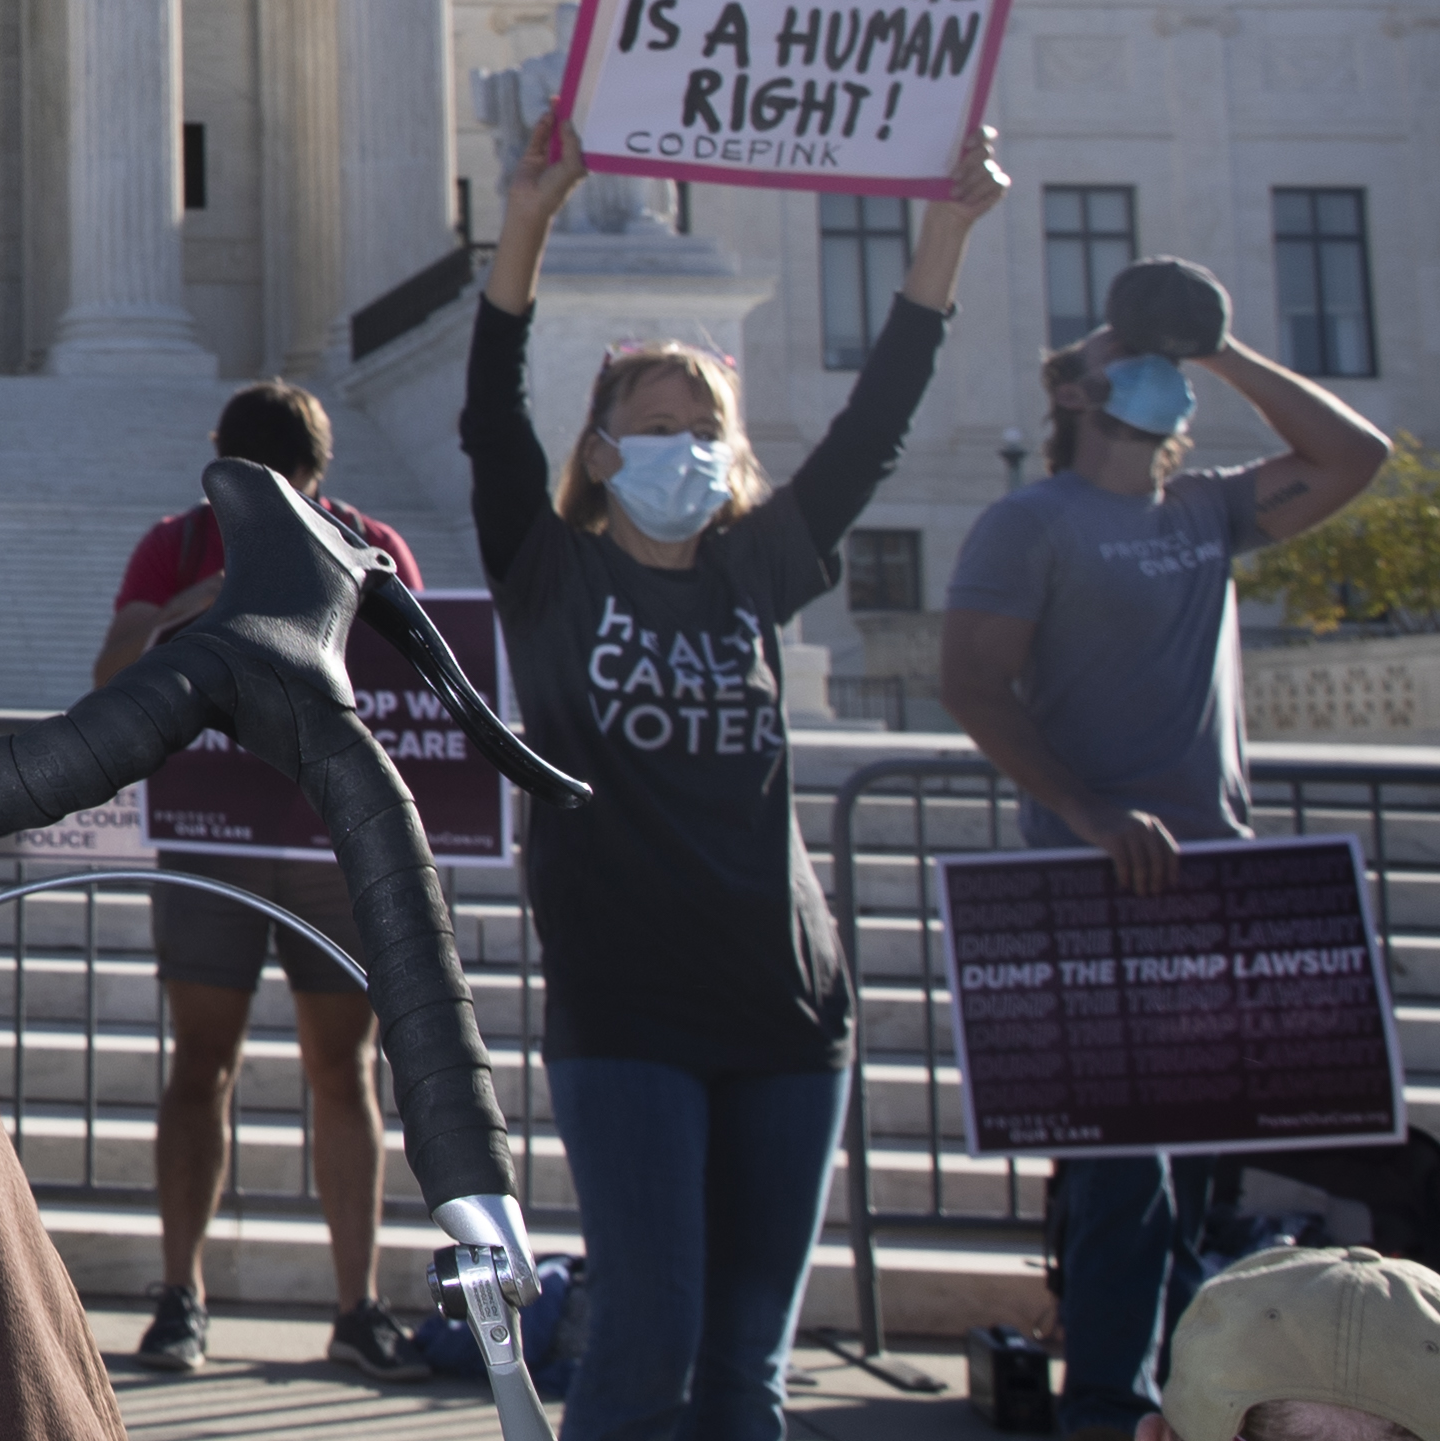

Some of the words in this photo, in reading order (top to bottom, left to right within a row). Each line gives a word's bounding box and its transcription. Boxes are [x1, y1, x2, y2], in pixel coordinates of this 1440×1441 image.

[702, 2, 749, 67] A
[776, 6, 980, 80] HUMAN
[682, 69, 902, 141] RIGHT!
[625, 132, 842, 167] CODEPINK
[589, 643, 745, 702] CARE
[354, 690, 397, 721] OP
[588, 691, 784, 754] VOTER
[373, 730, 467, 759] CARE
[76, 810, 141, 828] COUR
[15, 830, 96, 849] POLICE
[962, 962, 1052, 991] DUMP
[1060, 958, 1116, 986] THE
[1124, 954, 1226, 983] TRUMP
[1233, 946, 1366, 978] LAWSUIT
